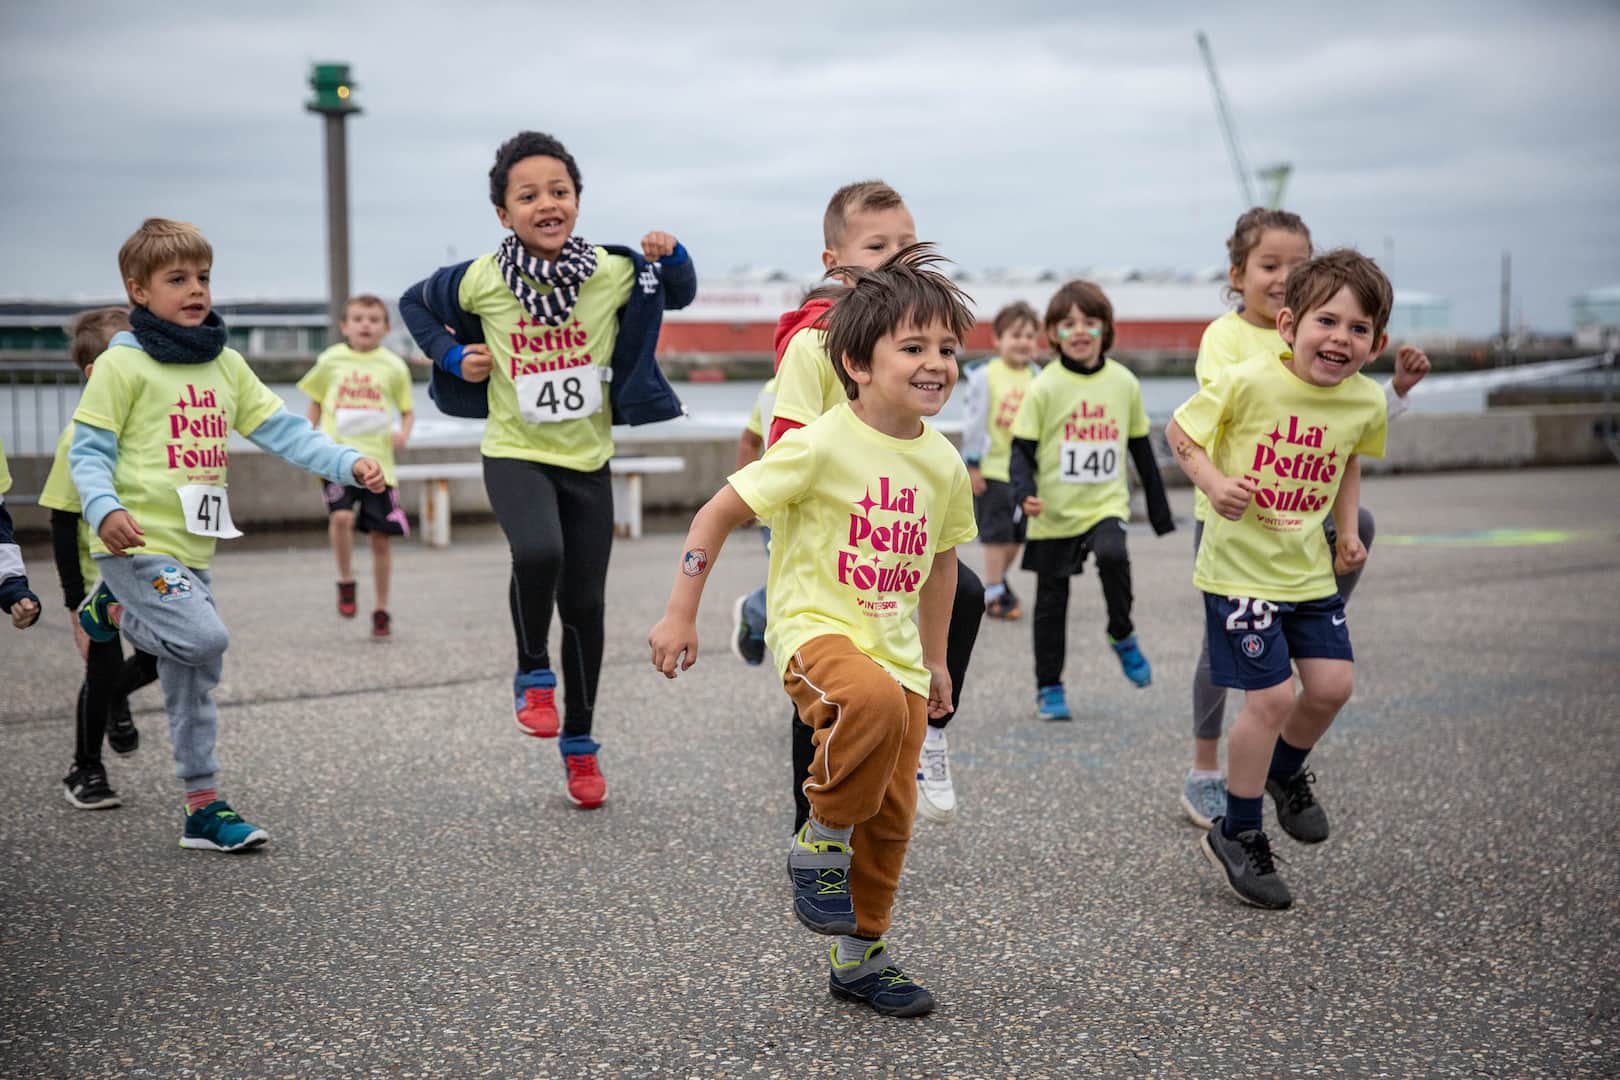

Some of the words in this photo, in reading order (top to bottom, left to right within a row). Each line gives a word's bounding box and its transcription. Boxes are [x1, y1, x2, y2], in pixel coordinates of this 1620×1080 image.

[510, 328, 588, 354] Petite
[186, 384, 217, 408] La
[536, 377, 585, 414] 48
[1082, 400, 1104, 418] La
[1064, 423, 1119, 441] Petite
[1287, 416, 1324, 449] La
[166, 444, 229, 469] Foulé
[1064, 449, 1116, 477] 140
[1252, 443, 1337, 484] Petite
[879, 477, 915, 514] La
[197, 494, 221, 531] 47
[848, 513, 928, 556] Petite
[838, 550, 921, 593] Foulée
